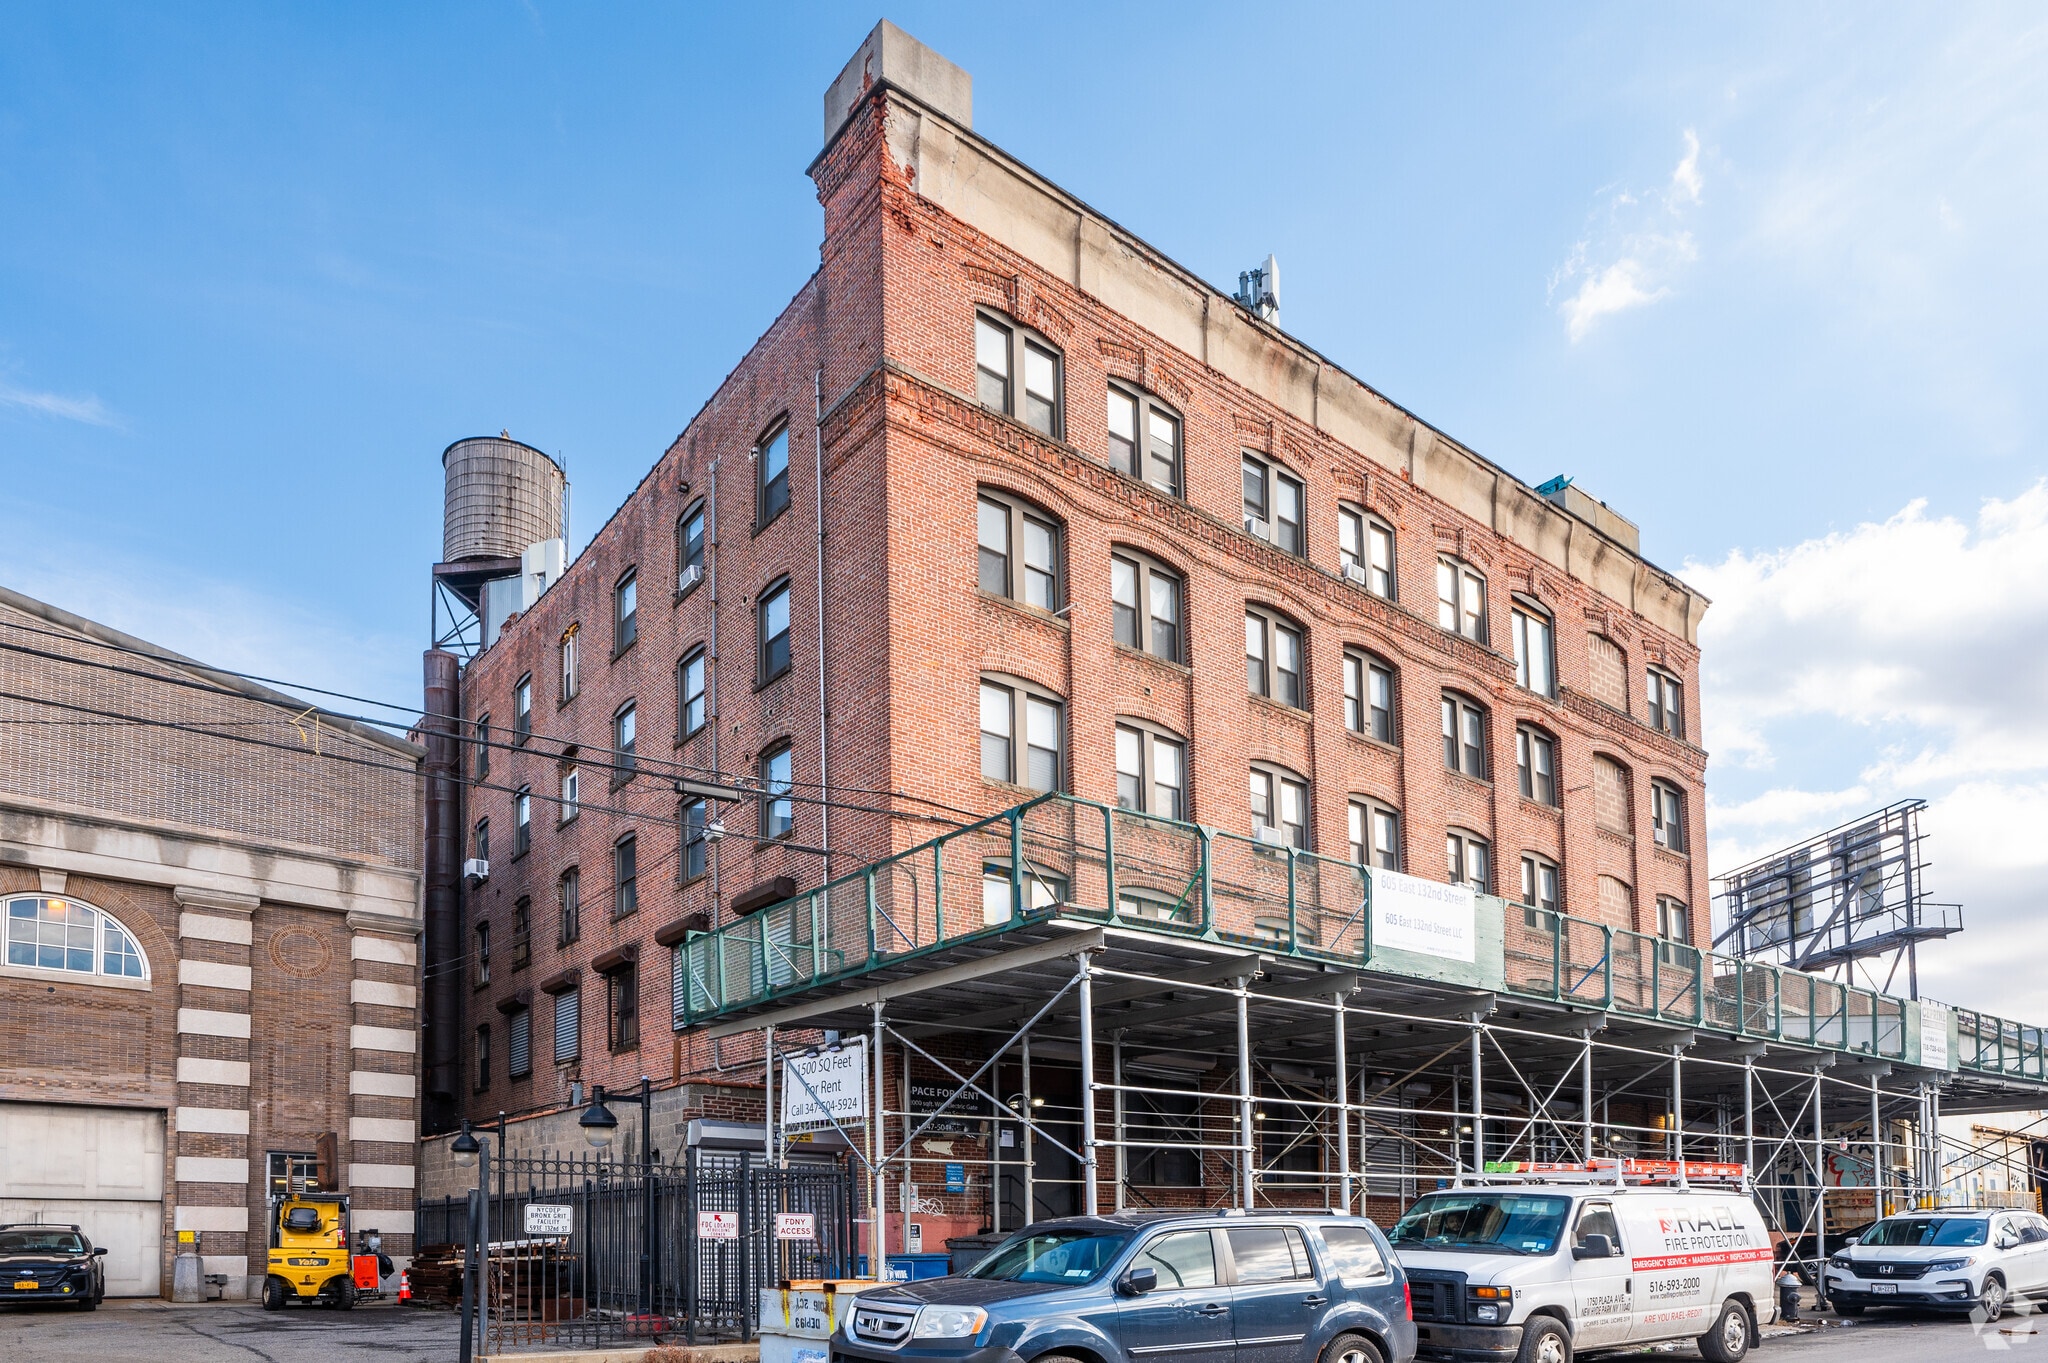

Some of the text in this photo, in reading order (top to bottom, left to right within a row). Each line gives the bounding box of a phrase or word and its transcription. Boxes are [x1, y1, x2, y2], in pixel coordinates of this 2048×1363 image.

[1381, 874, 1467, 907] 605 East 132nd Street
[1385, 913, 1463, 939] 605 East 132nd Street LLC
[798, 1054, 852, 1076] 1500 SQ Feet
[821, 1079, 842, 1094] Rent
[910, 1086, 935, 1096] PACE
[791, 1104, 804, 1116] Call
[1946, 1152, 1958, 1166] NO
[1673, 1206, 1745, 1233] RAEL
[1665, 1234, 1749, 1252] FIRE PROTECTION
[1634, 1259, 1666, 1268] EMERGENCY
[1667, 1257, 1687, 1266] SERVICE
[1692, 1254, 1726, 1264] MAINTENANCE
[1730, 1252, 1756, 1260] INSPECTIONS
[1650, 1277, 1700, 1292] 516-593-2000
[1599, 1295, 1613, 1305] PLAZA
[1581, 1308, 1591, 1316] NEW
[1602, 1305, 1612, 1314] PARK
[1613, 1304, 1619, 1312] NY
[1644, 1315, 1656, 1324] ARE
[1657, 1313, 1670, 1322] YOU
